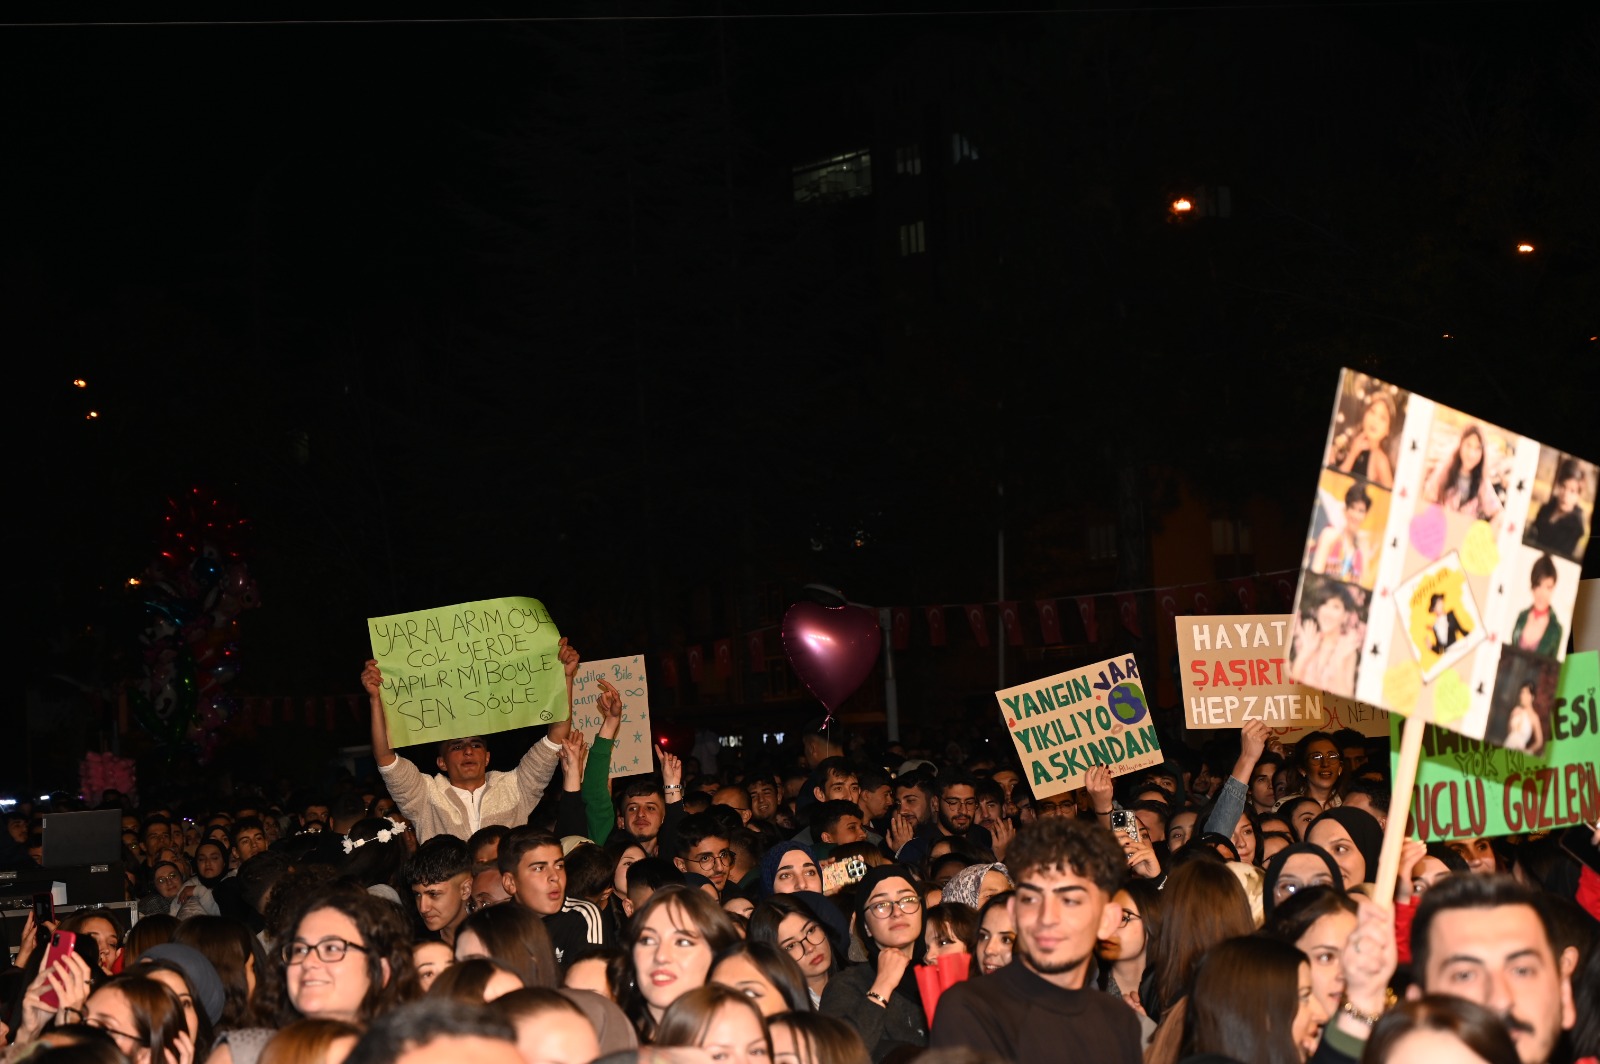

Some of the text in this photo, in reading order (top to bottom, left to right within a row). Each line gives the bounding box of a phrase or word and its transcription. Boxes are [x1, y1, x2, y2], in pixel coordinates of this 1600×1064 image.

[375, 609, 504, 656] YARALARIM
[457, 633, 530, 668] YERDE
[1192, 621, 1287, 651] HAYAT
[484, 653, 553, 686] BÖYLE
[611, 664, 633, 682] Bile
[1002, 658, 1139, 720] YANGIN VAR
[397, 687, 539, 731] SEN SÖYLE
[1013, 705, 1112, 753] YIKILIYO
[1031, 724, 1160, 785] AŞKINDAN
[1455, 750, 1498, 778] YOK
